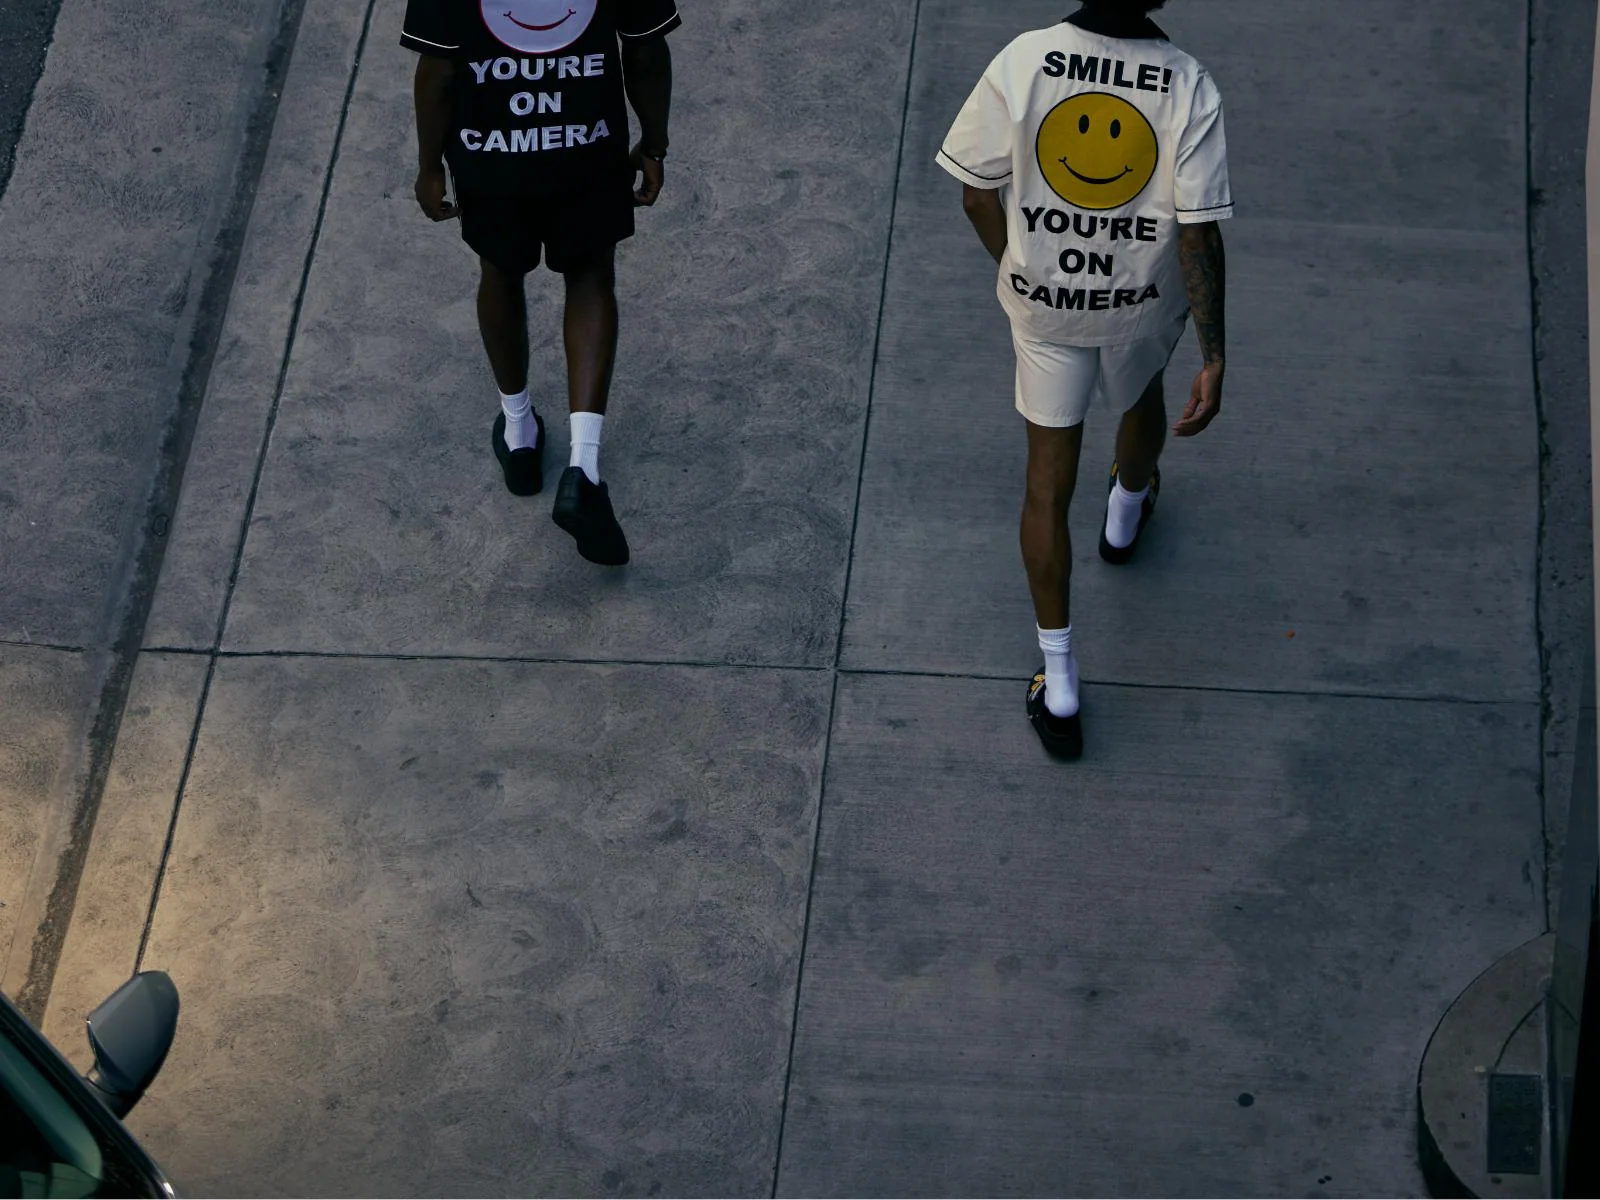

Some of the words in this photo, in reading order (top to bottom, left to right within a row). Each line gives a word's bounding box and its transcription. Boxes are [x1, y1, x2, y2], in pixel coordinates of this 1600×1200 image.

[469, 53, 605, 84] YOU'RE
[1042, 51, 1173, 93] SMILE!
[509, 91, 562, 116] ON
[460, 119, 610, 152] CAMERA
[1021, 207, 1157, 242] YOU'RE
[1058, 248, 1113, 276] ON
[1010, 273, 1160, 311] CAMERA
